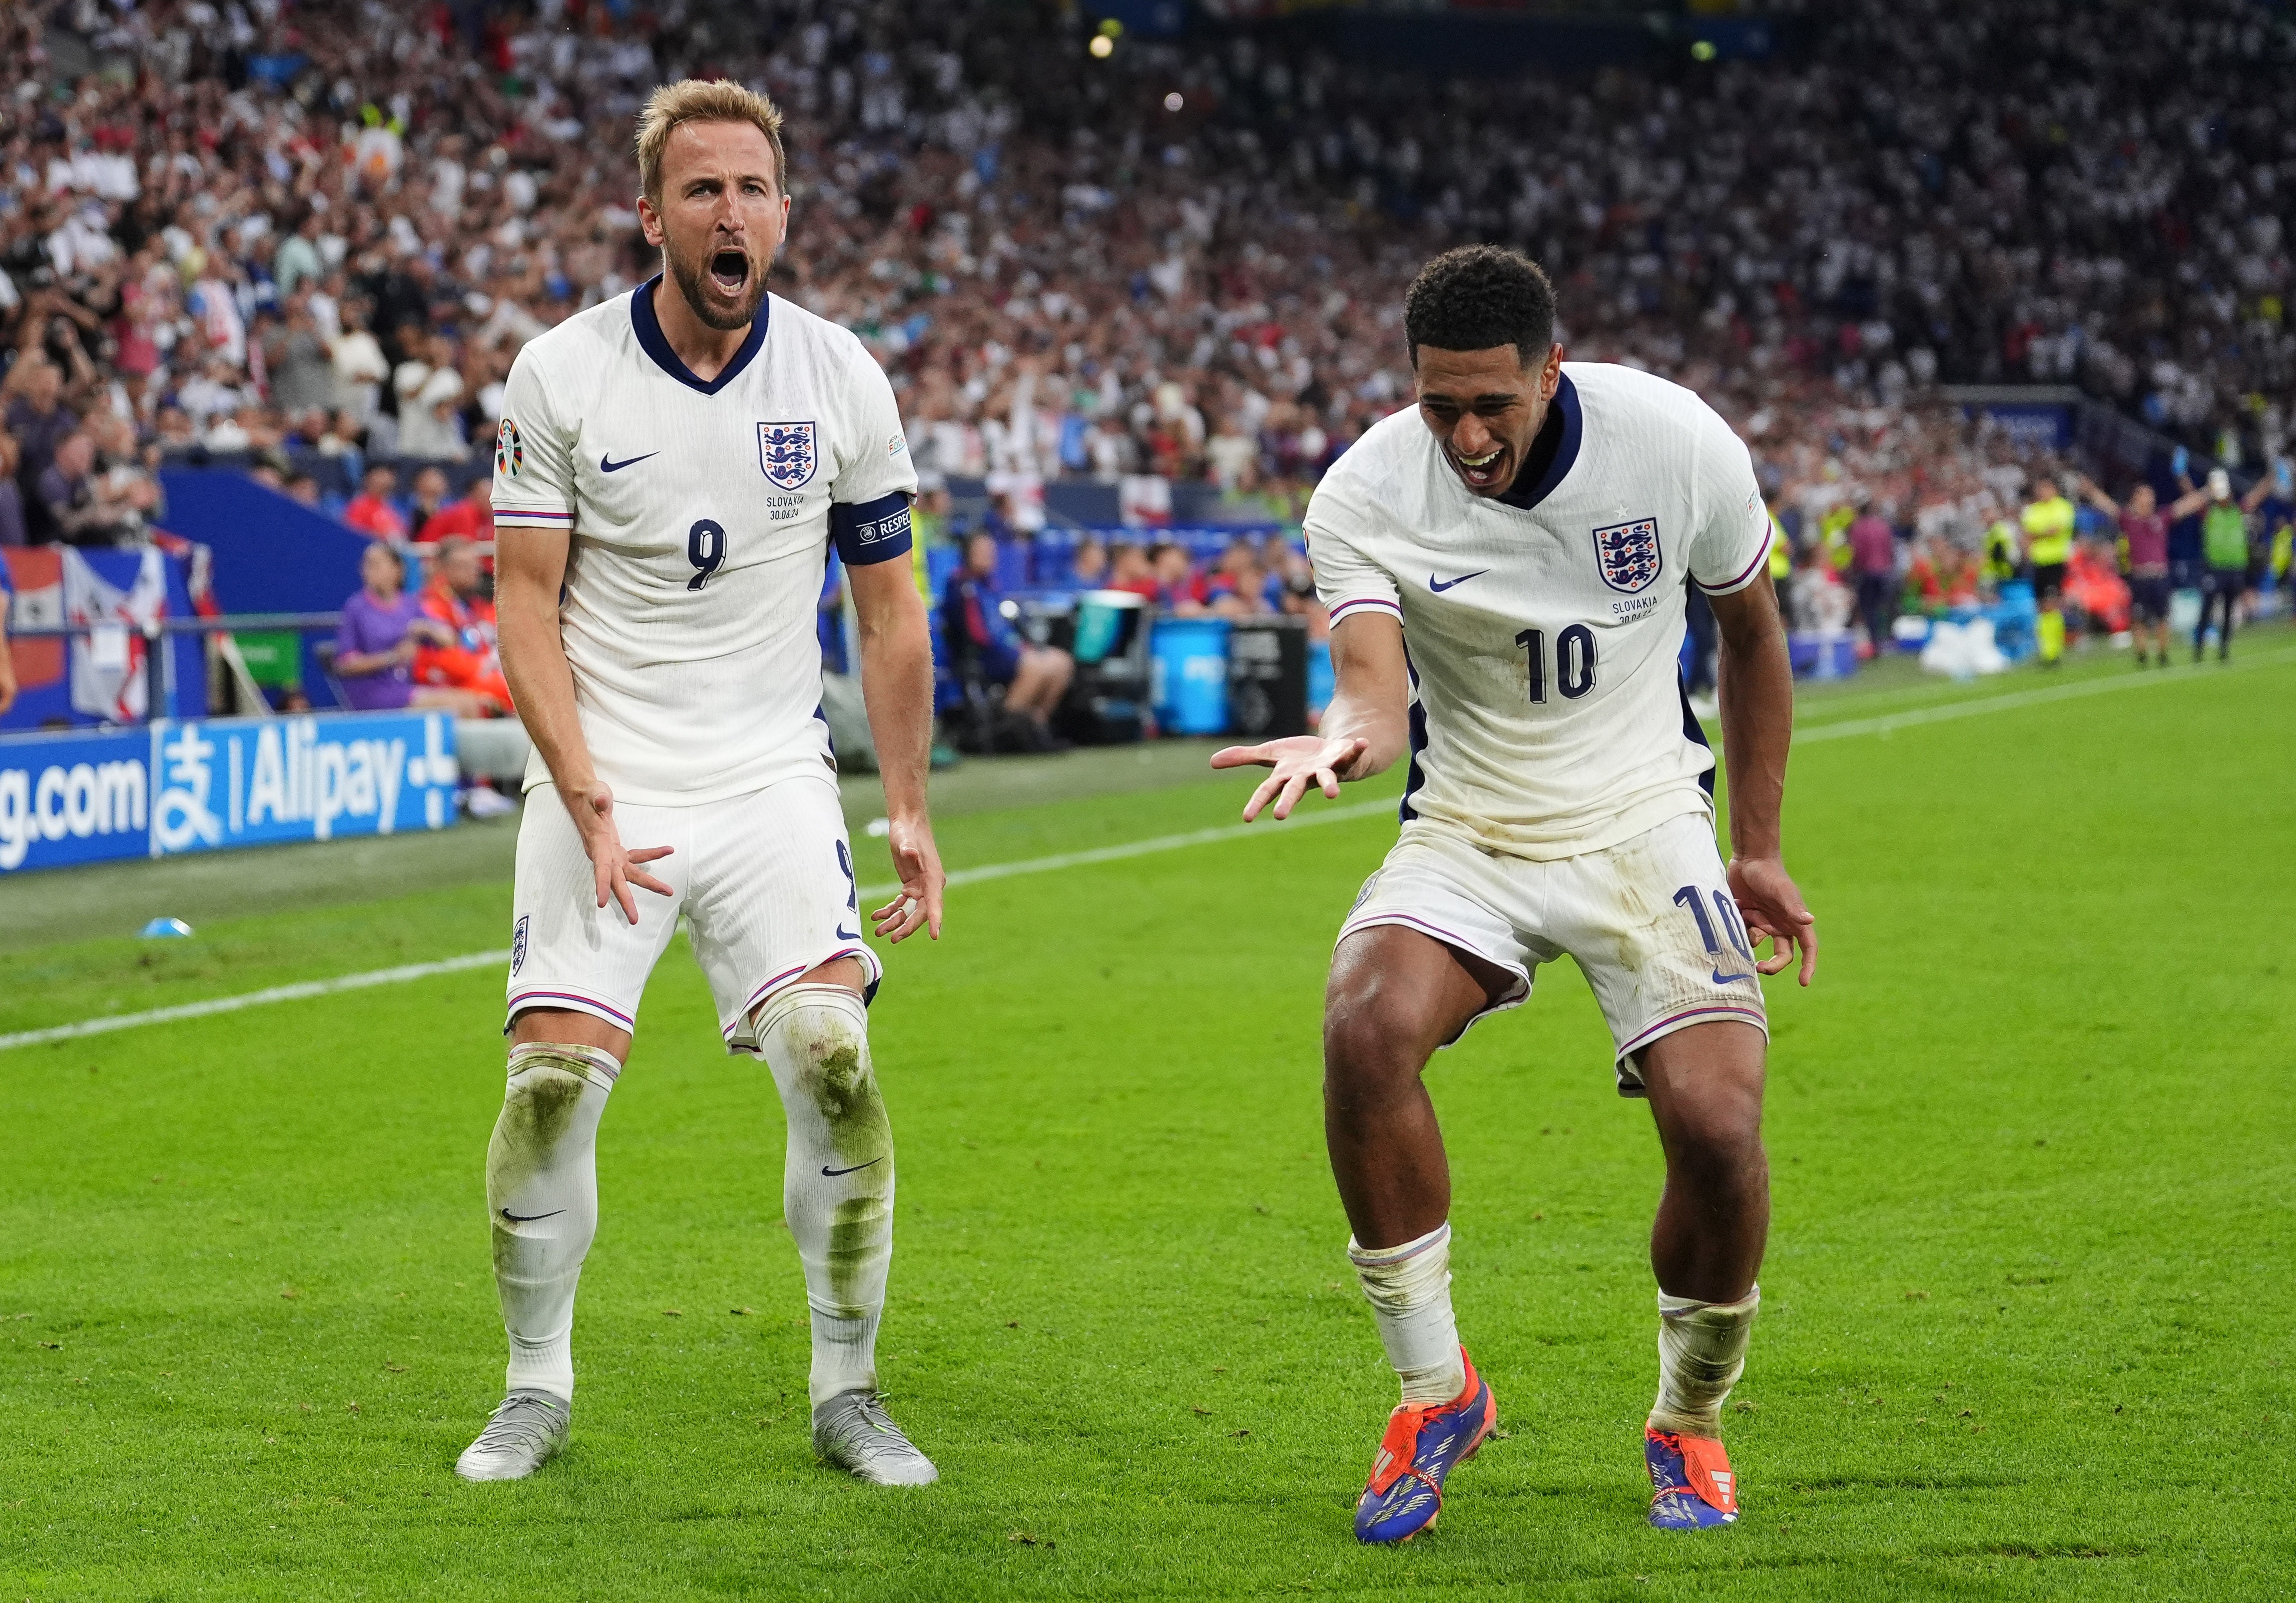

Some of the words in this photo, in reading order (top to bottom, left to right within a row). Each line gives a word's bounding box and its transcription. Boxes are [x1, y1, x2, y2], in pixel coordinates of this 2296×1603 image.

[767, 496, 804, 507] SLOVAKIA
[770, 508, 799, 520] 30.06.24
[687, 519, 727, 592] 9
[1613, 596, 1657, 614] SLOVAKIA
[1515, 624, 1598, 704] 10
[836, 839, 856, 914] 9
[1673, 885, 1754, 966] 10
